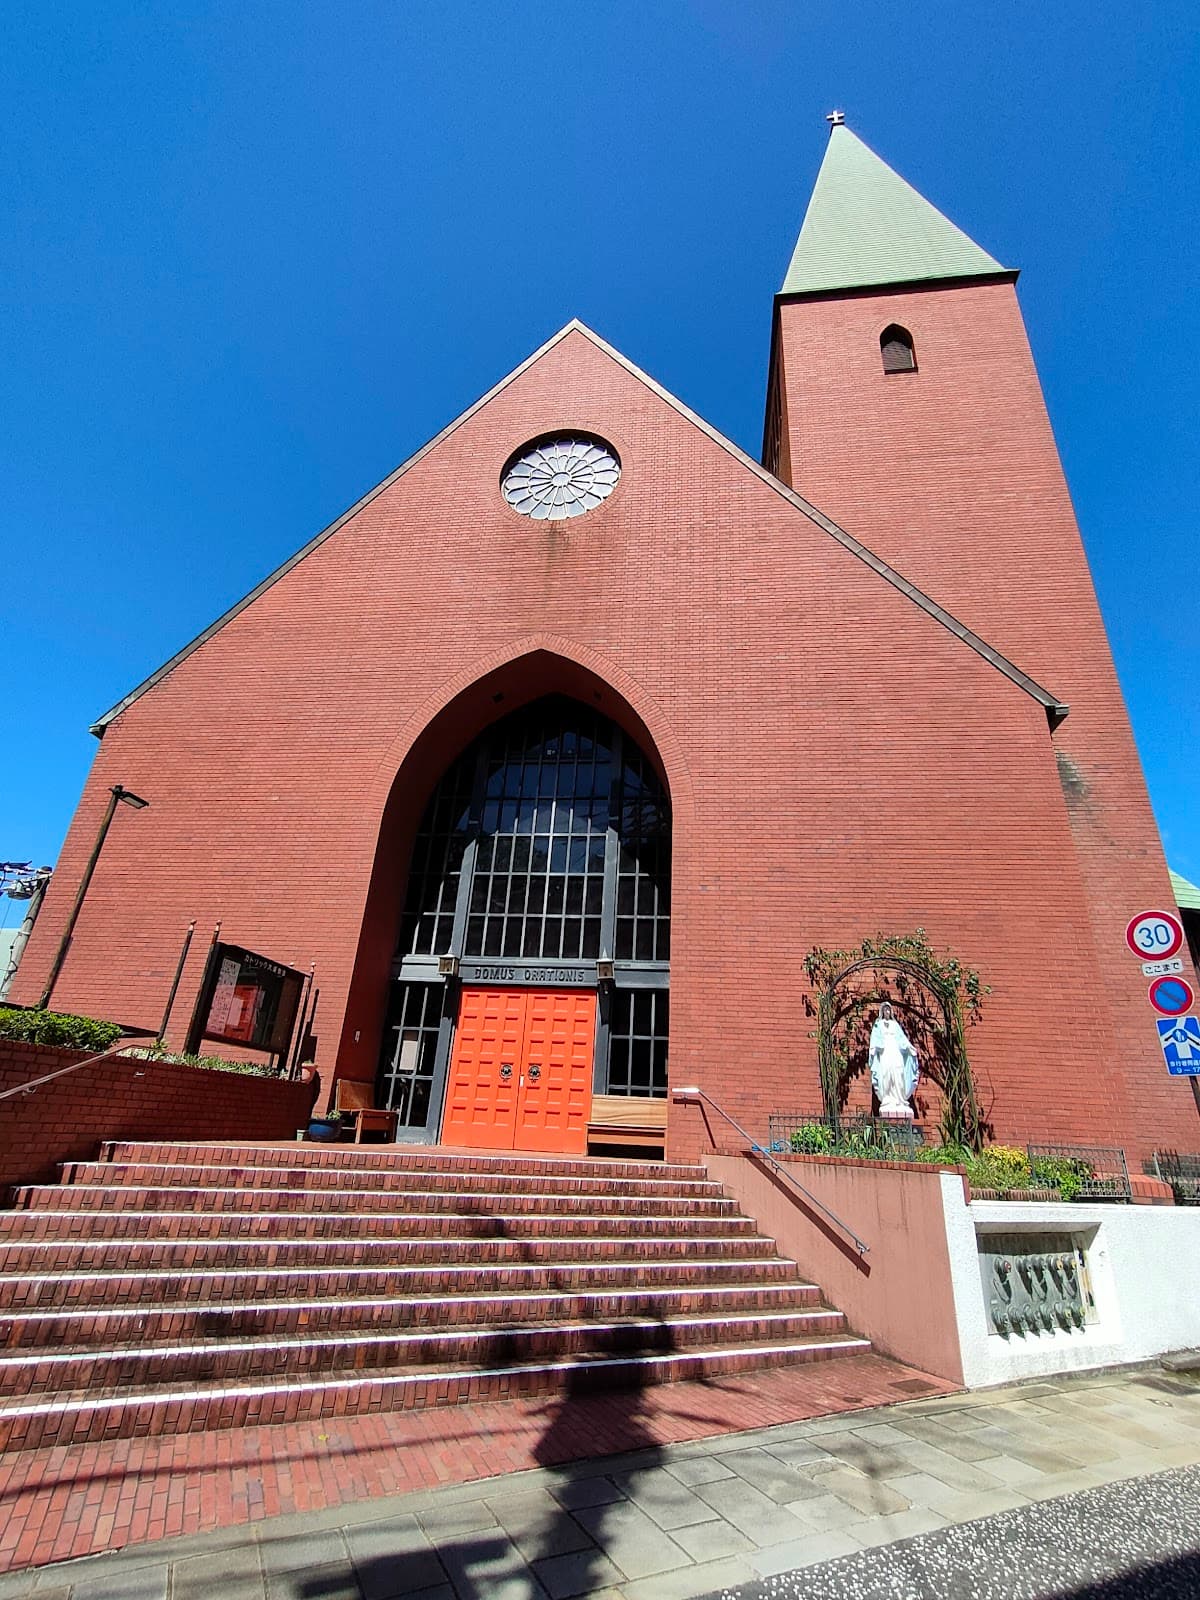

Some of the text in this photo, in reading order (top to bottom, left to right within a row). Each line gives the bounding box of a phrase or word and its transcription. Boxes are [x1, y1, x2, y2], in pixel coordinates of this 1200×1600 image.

[1138, 924, 1171, 948] 30
[474, 967, 585, 982] DOMUS ORATIONIS
[1145, 962, 1180, 974] ここまで
